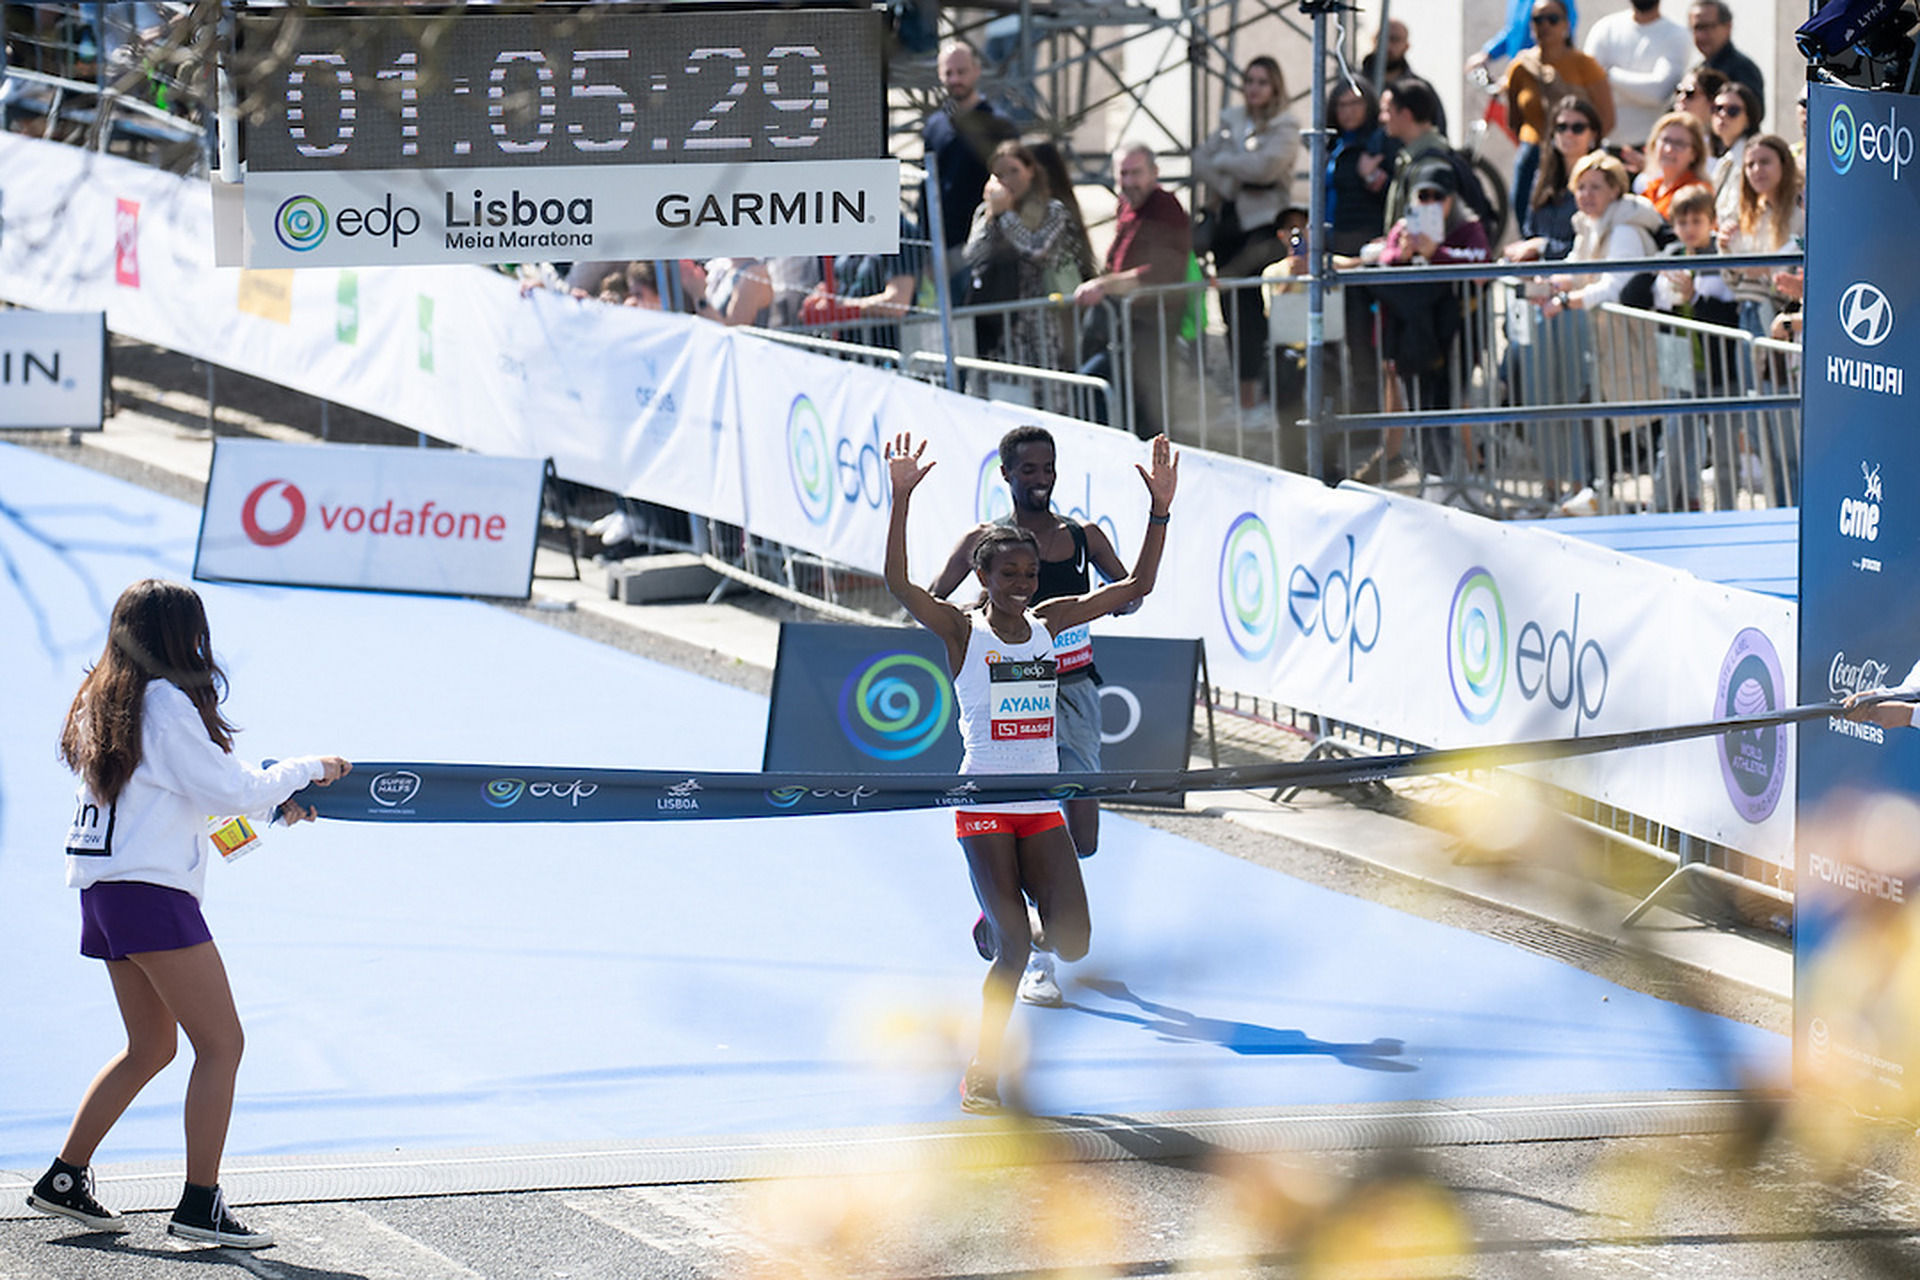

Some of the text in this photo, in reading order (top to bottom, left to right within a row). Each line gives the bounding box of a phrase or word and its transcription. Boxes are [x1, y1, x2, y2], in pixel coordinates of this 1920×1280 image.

[1857, 0, 1887, 28] LYNX
[287, 46, 830, 158] 01:05:29
[1859, 106, 1914, 181] edp
[335, 192, 421, 248] edp
[445, 189, 593, 228] Lisboa
[655, 190, 866, 229] GARMIN
[445, 230, 594, 249] Meia Maratona
[1826, 355, 1904, 396] HYUNDAI
[319, 499, 507, 541] vodafone
[1838, 497, 1881, 542] cme
[1287, 533, 1382, 684] edp
[1023, 663, 1045, 678] edp
[1515, 592, 1609, 738] edp
[999, 696, 1052, 713] AYANA
[1828, 715, 1885, 745] PARTNERS
[656, 798, 700, 810] LISBOA
[1808, 852, 1907, 906] POWERADE
